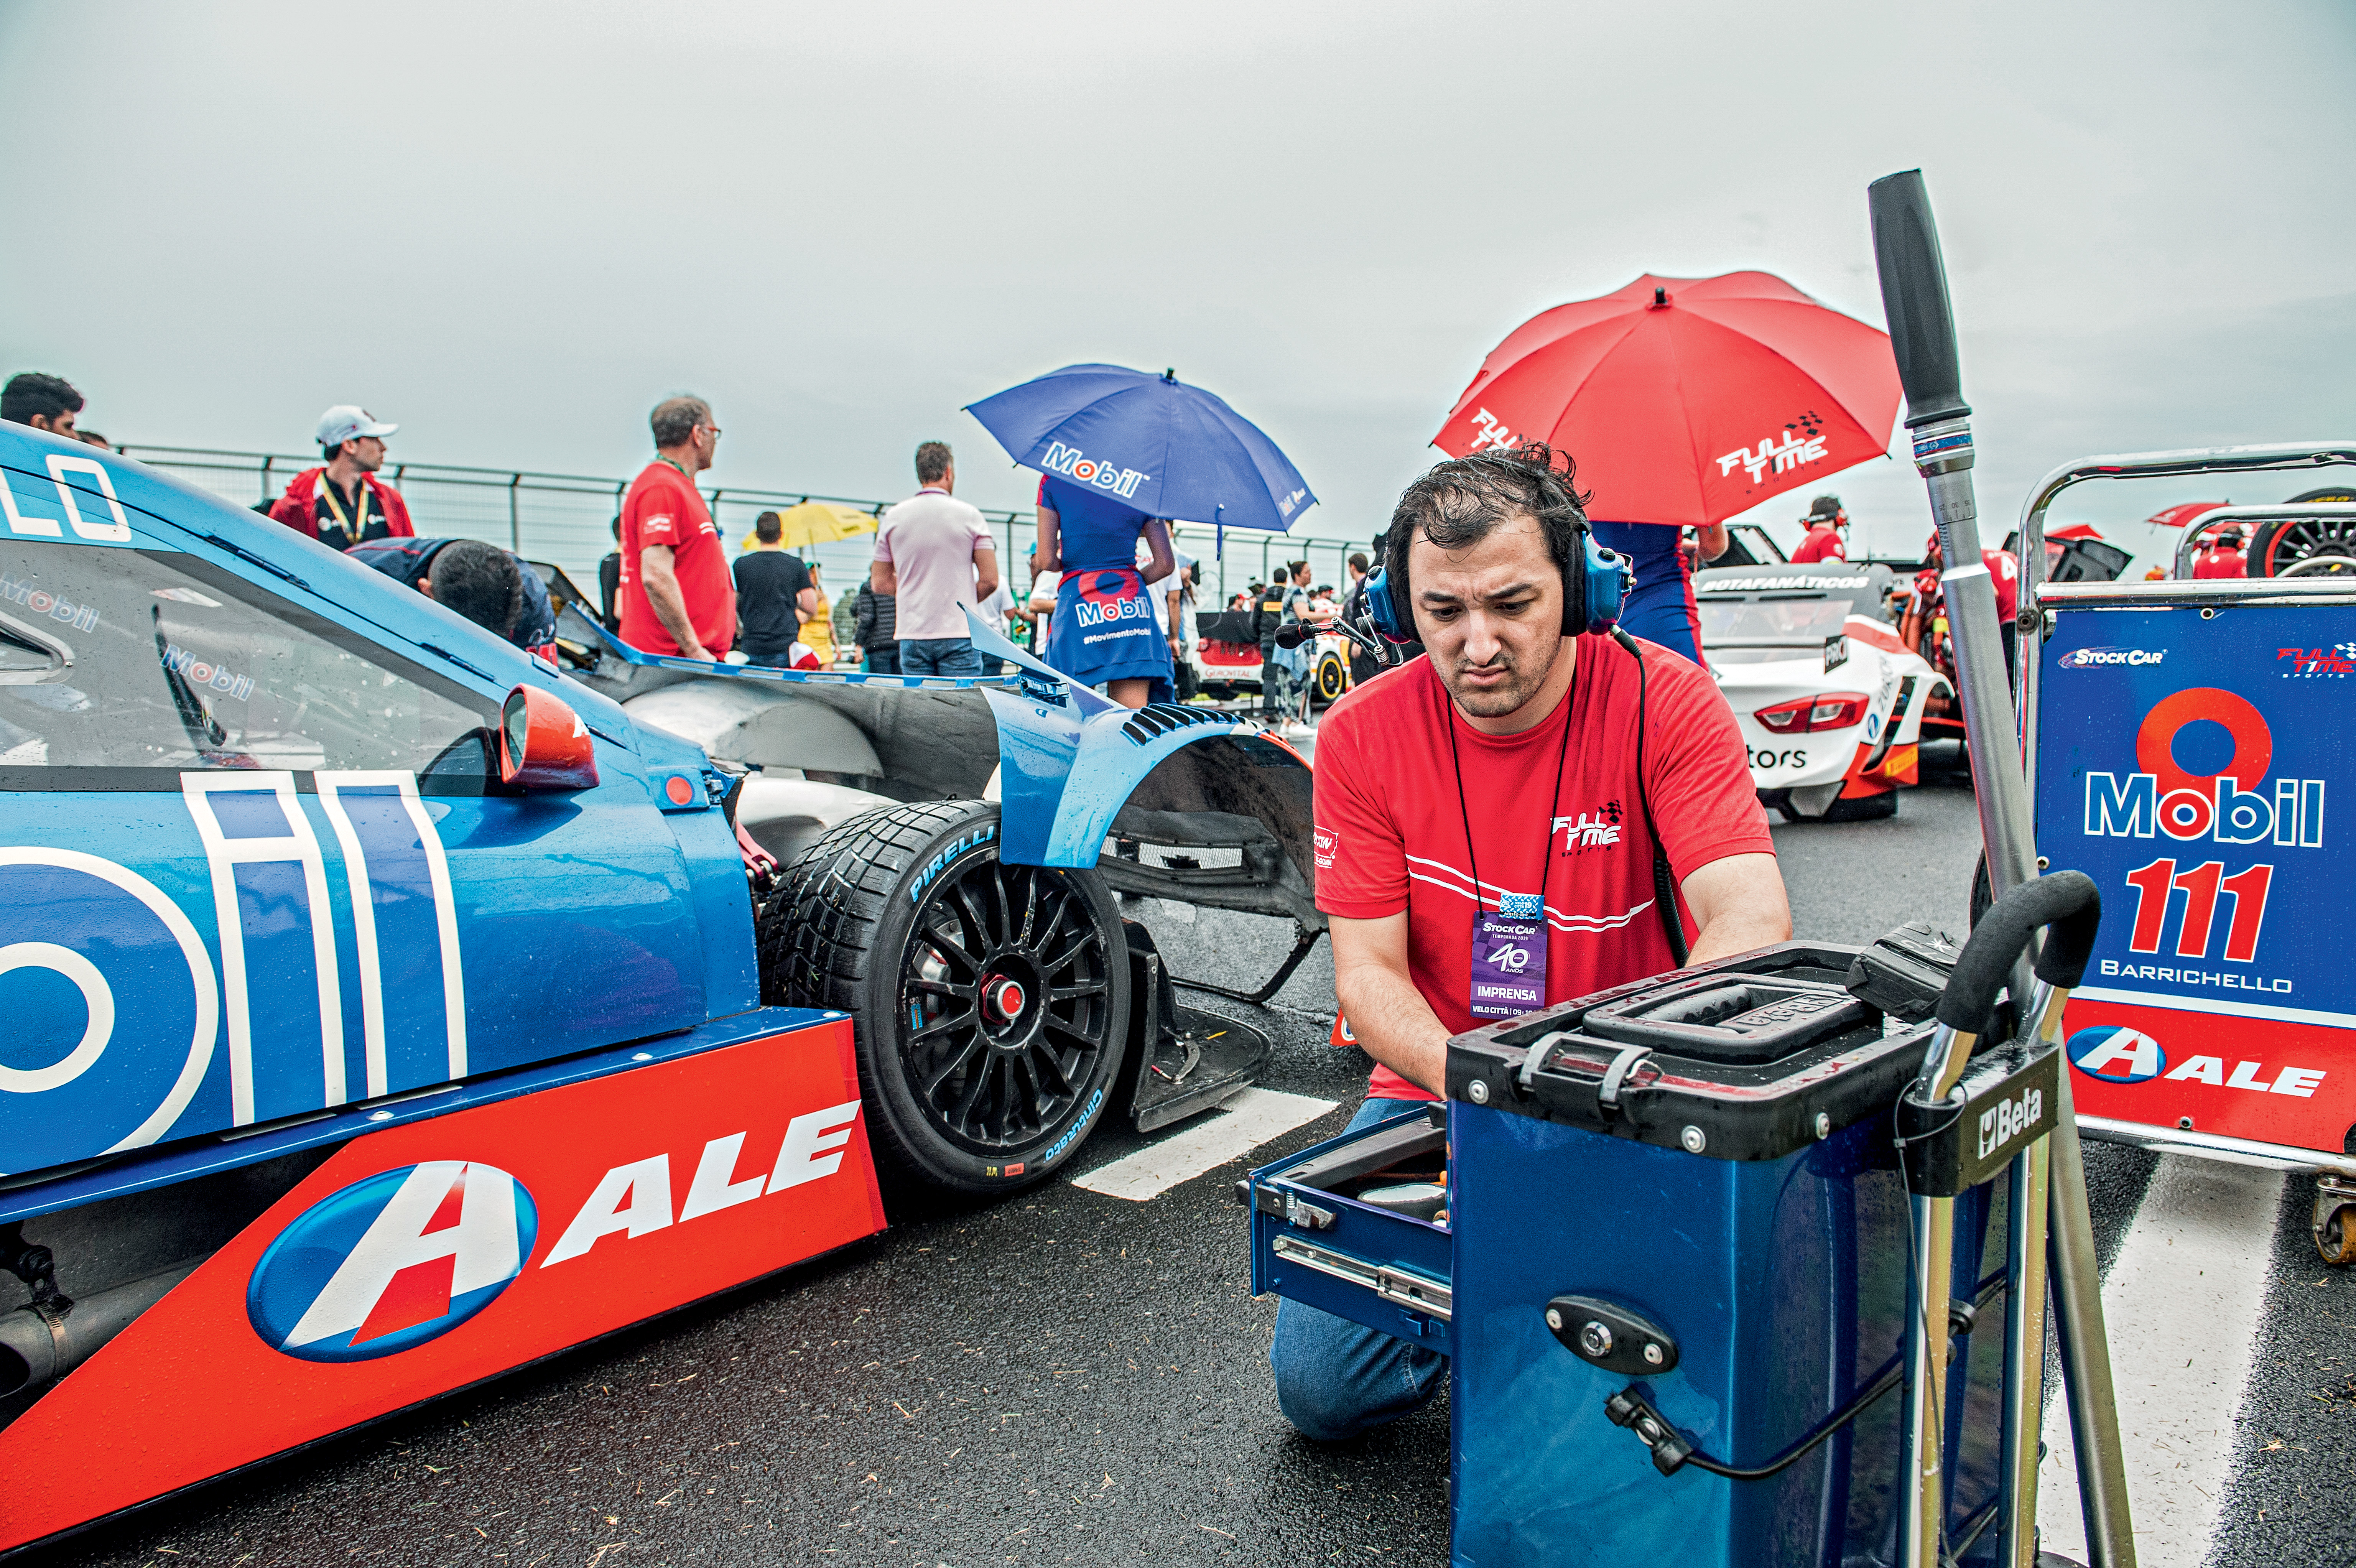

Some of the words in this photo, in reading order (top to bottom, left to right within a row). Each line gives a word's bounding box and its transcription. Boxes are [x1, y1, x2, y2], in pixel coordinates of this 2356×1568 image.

[1041, 441, 1143, 499] Mobil
[1716, 430, 1806, 477] FULL
[1075, 596, 1150, 627] Mobil
[1825, 635, 1848, 667] PRO
[2276, 648, 2344, 660] FULL
[160, 644, 255, 702] Mobil
[1550, 811, 1607, 834] FULL
[2085, 772, 2325, 848] Mobil
[910, 826, 994, 902] PIRELLI
[2125, 857, 2274, 963] 111
[1487, 943, 1531, 972] 40
[2100, 959, 2292, 994] BARRICHELLO
[1472, 1005, 1489, 1013] VELO
[1490, 1006, 1509, 1015] CITTÀ
[1477, 985, 1537, 1001] IMPRENSA
[2164, 1055, 2327, 1098] ALE
[1997, 1088, 2042, 1147] Beta
[540, 1099, 862, 1269] ALE
